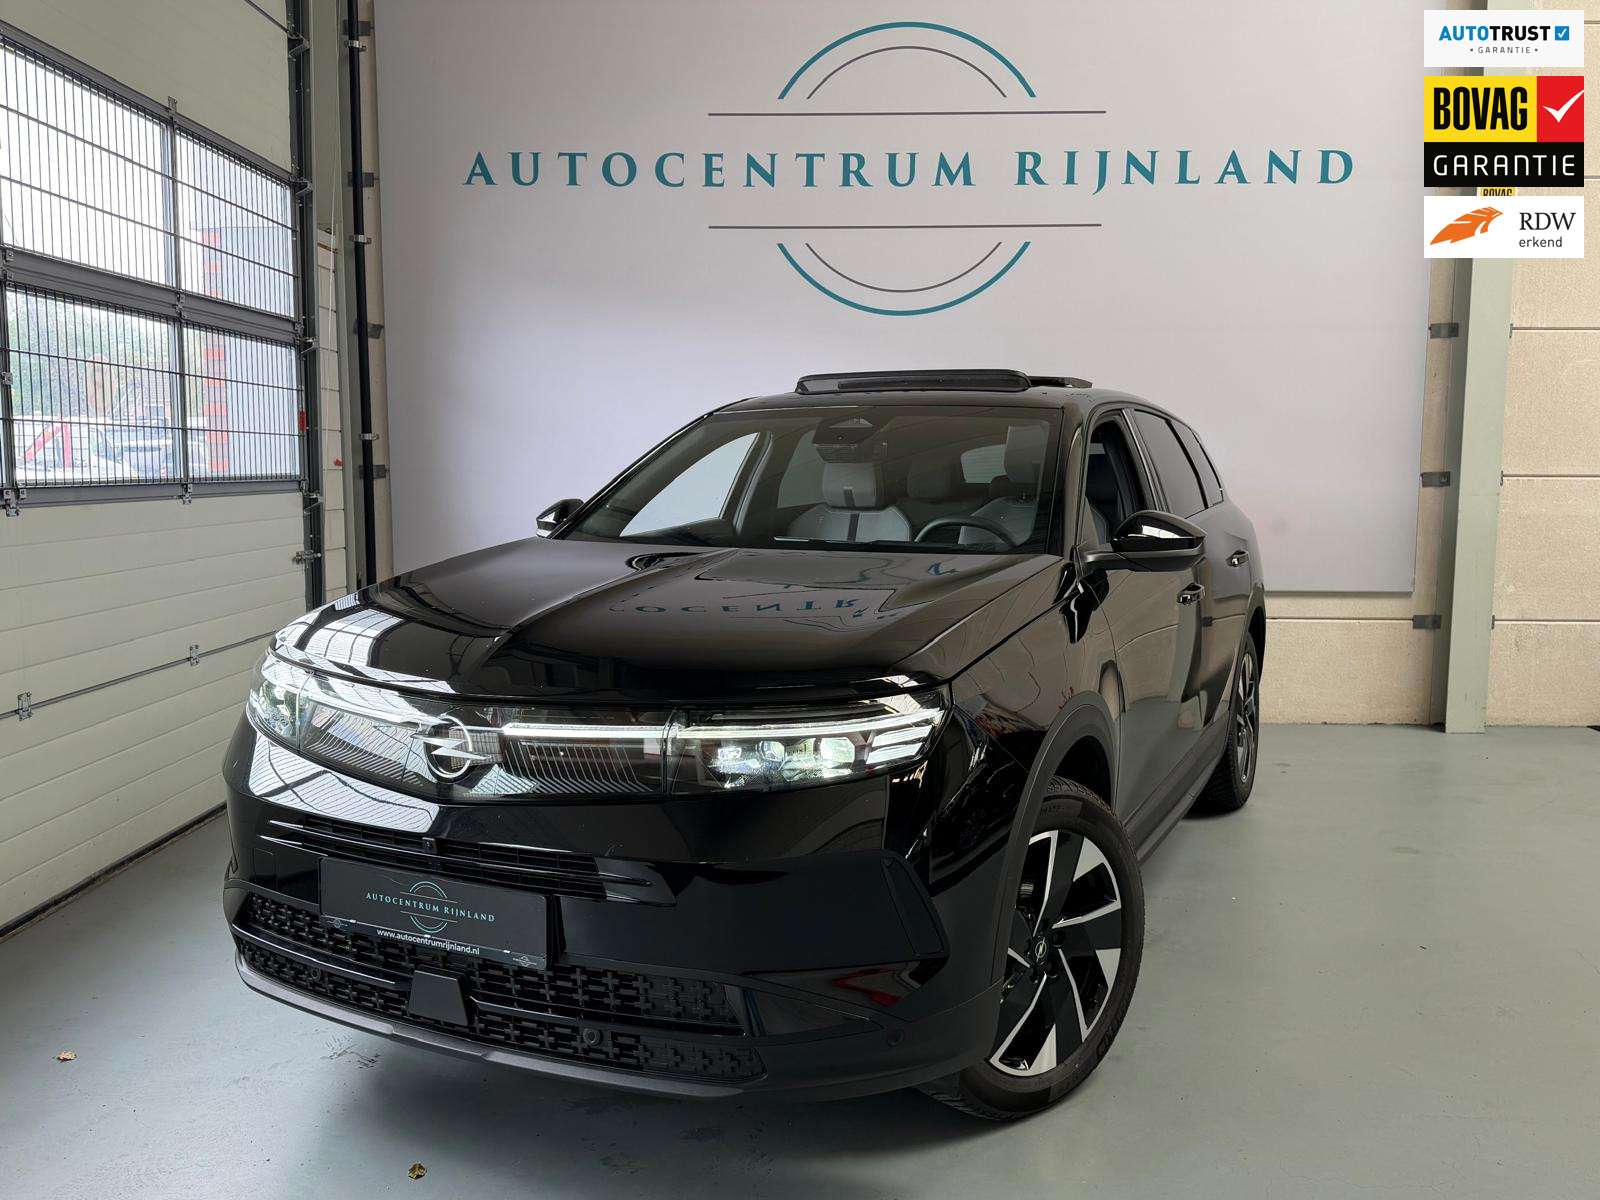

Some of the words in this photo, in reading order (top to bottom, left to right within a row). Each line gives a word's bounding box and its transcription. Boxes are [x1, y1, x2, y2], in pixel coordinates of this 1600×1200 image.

[462, 151, 974, 188] AUTOCENTRUM
[1014, 149, 1354, 196] RIJNLAND
[365, 891, 440, 913] AUTOCENTRUM
[443, 906, 496, 923] RIJNLAND
[376, 927, 481, 956] www.autocentrumrijnland.nl
